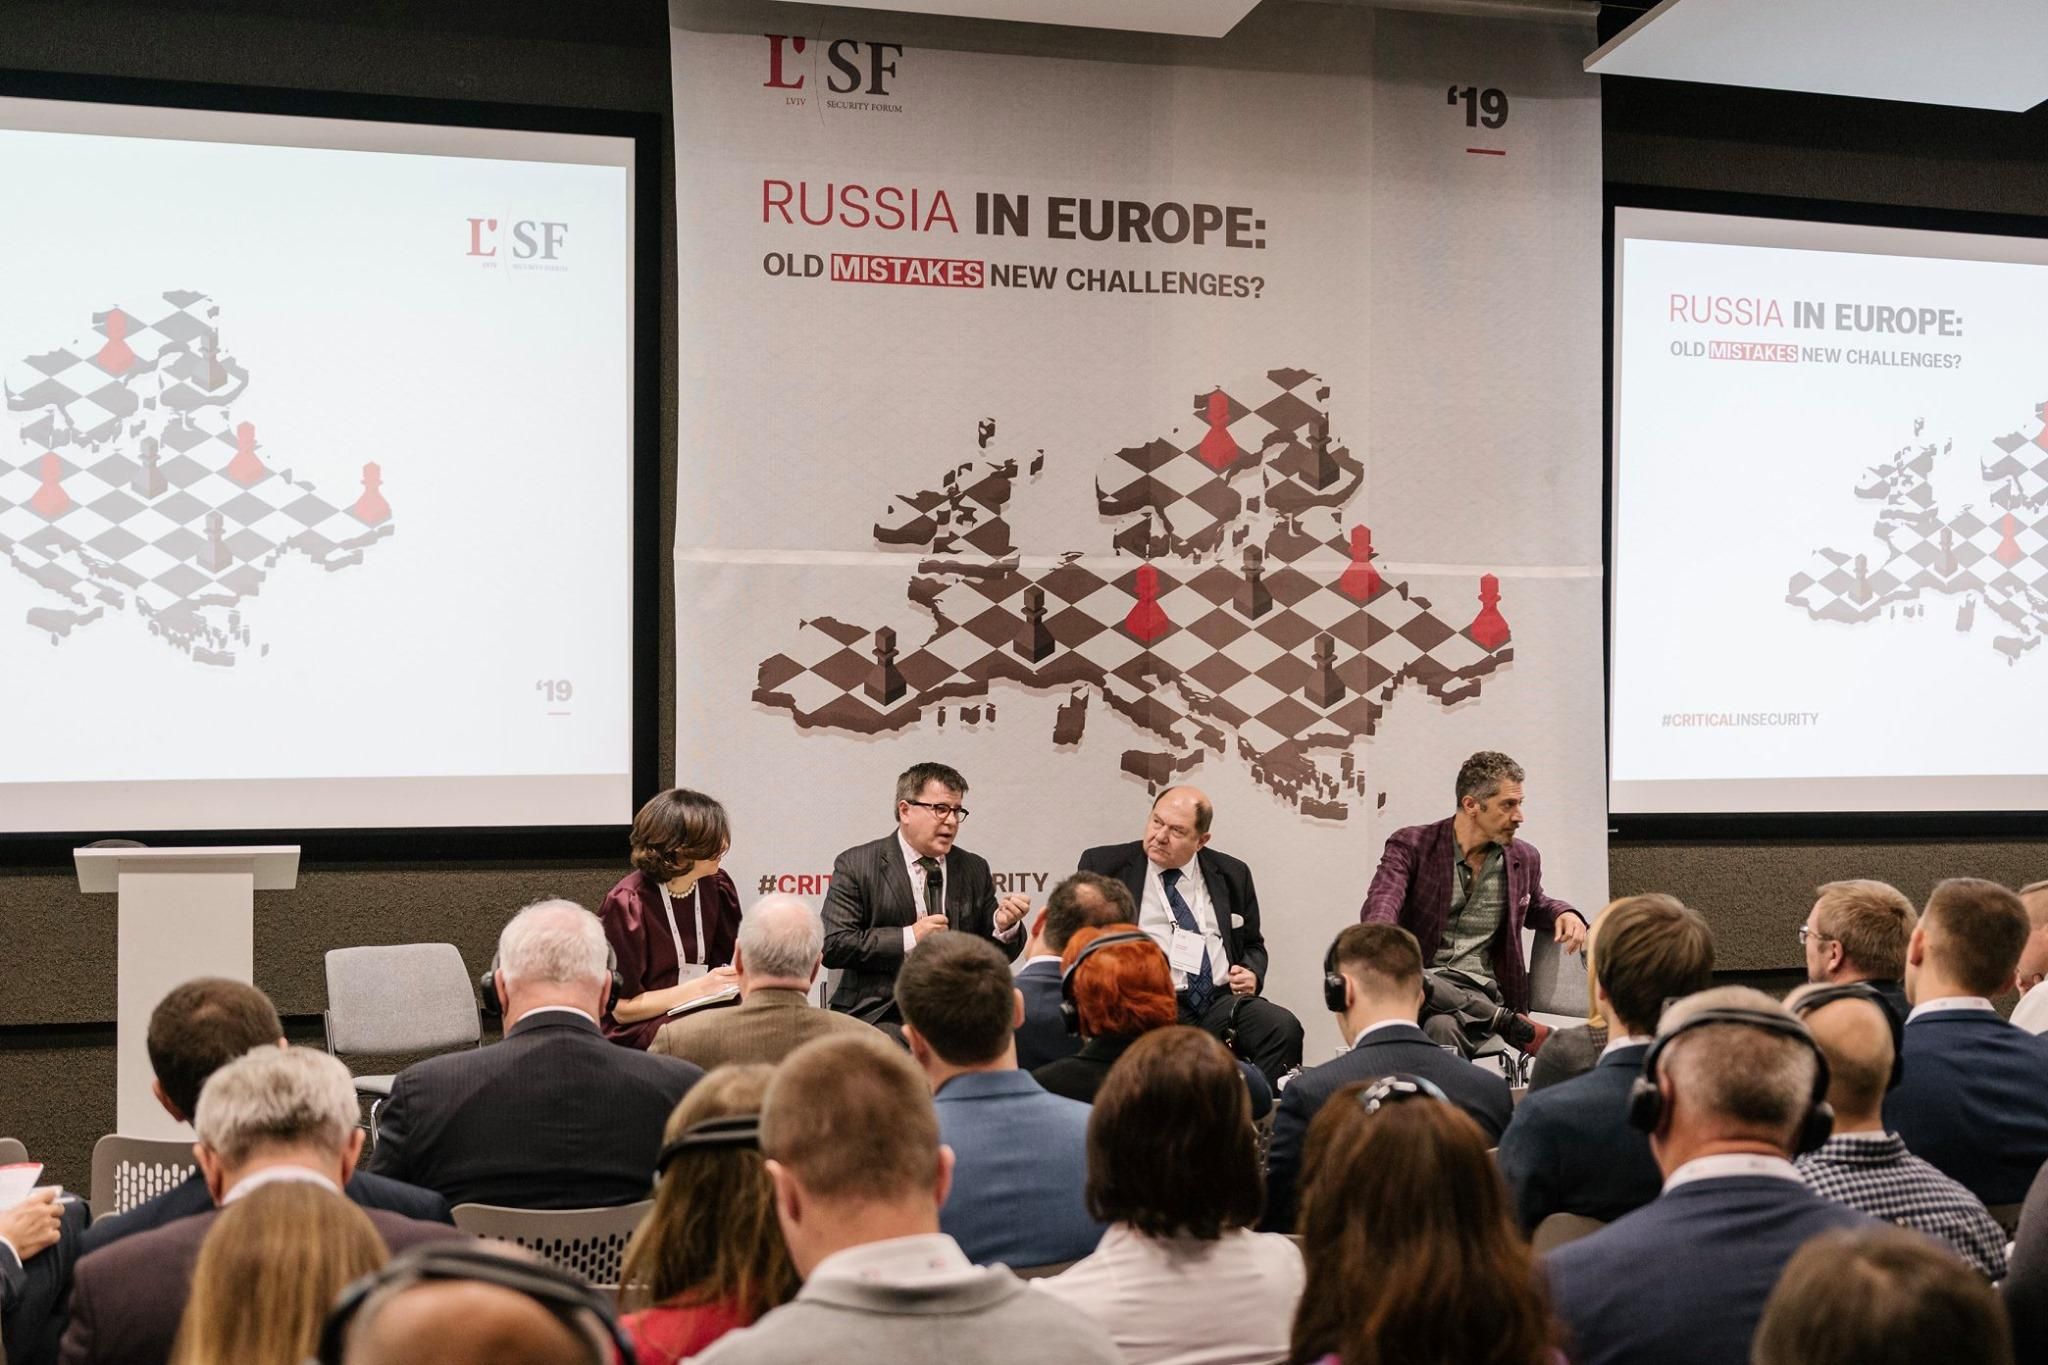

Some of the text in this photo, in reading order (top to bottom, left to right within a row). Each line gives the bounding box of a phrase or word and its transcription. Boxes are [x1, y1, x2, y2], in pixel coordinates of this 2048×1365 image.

[827, 39, 903, 96] SF
[786, 97, 902, 113] LVIV SECURITY FORUM
[763, 179, 1266, 249] RUSSIA IN EUROPE:
[512, 220, 569, 260] SF
[763, 252, 1265, 299] OLD MISTAKES NEW CHALLENGES?
[1670, 294, 1963, 337] RUSSIA IN EUROPE:
[1670, 341, 1962, 369] OLD MISTAKES NEW CHALLENGES?
[1662, 713, 1819, 727] #CRITICALINSECURITY
